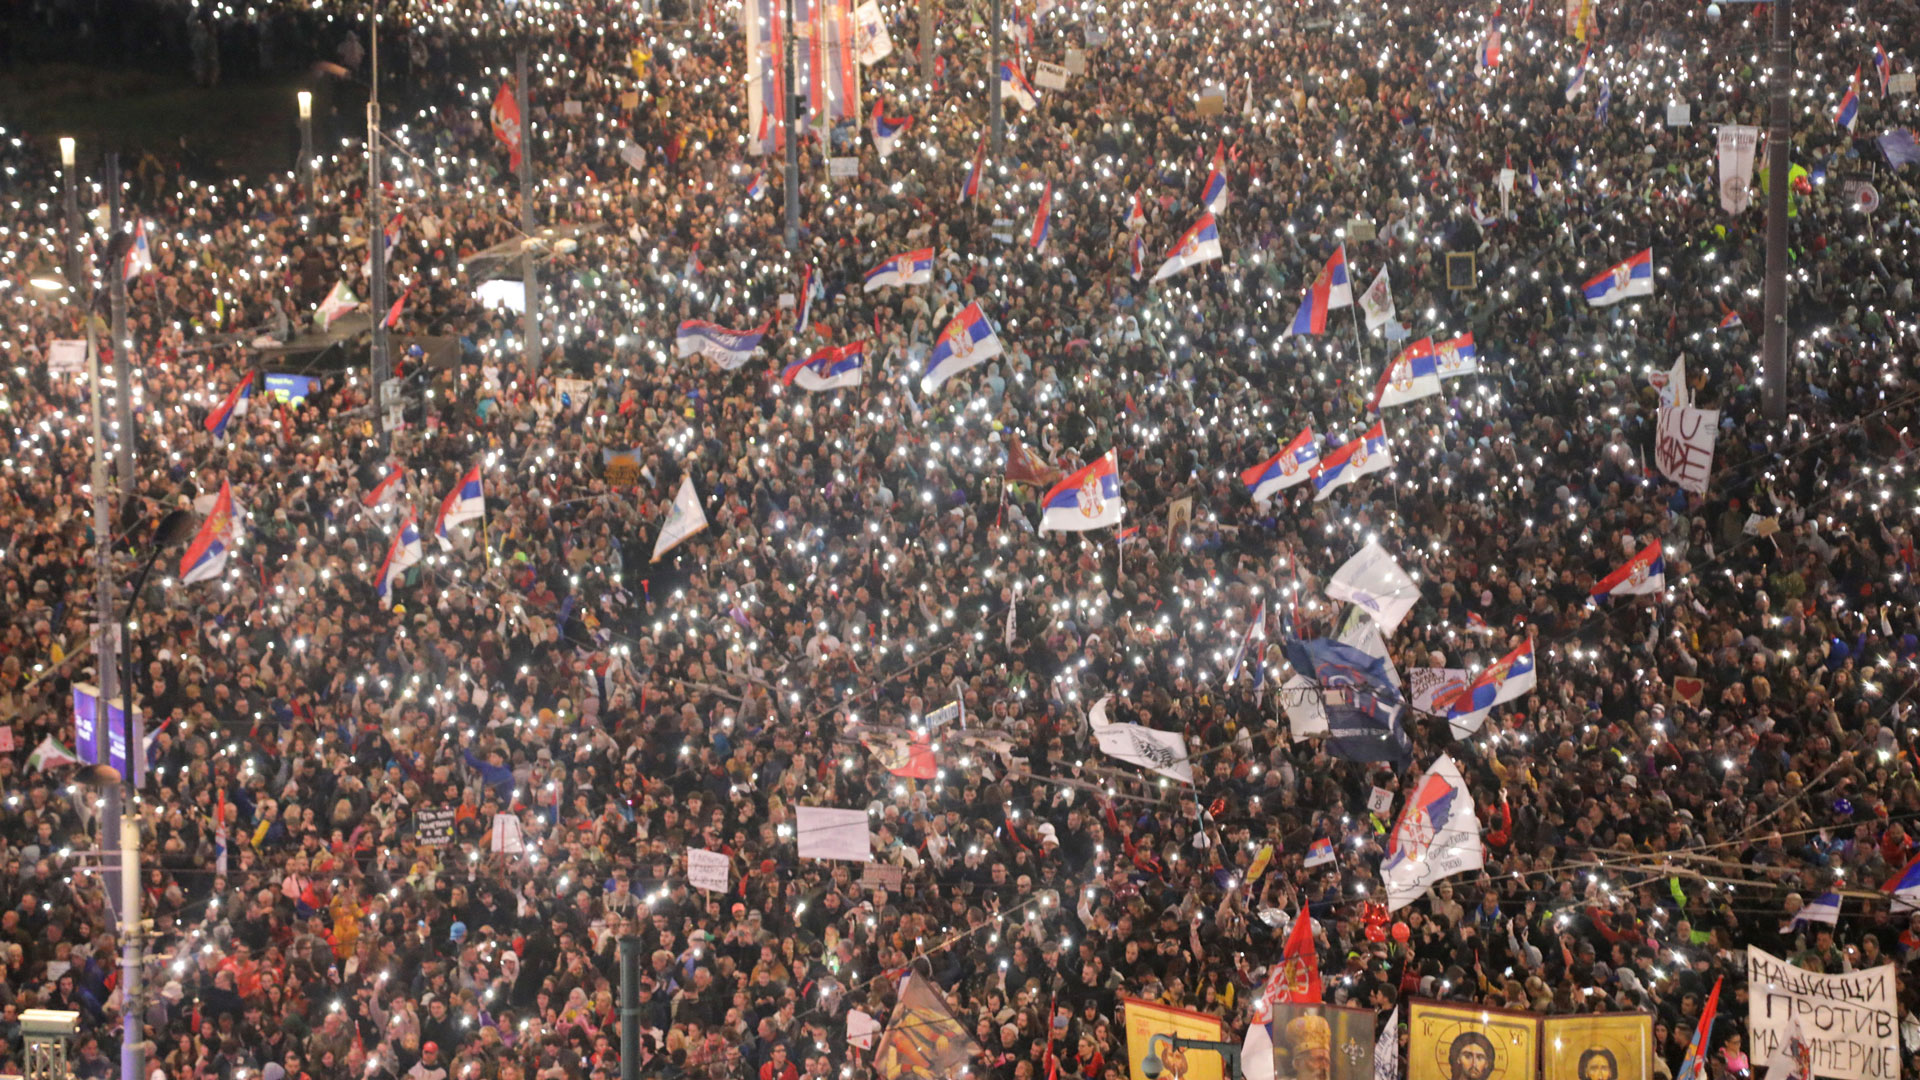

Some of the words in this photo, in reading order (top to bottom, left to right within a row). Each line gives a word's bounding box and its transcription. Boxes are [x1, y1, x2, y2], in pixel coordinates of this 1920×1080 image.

[1680, 409, 1702, 441] U
[1752, 957, 1885, 1003] МАШИНЦИ
[1766, 993, 1892, 1038] ПРОТИВ
[1753, 1028, 1896, 1079] МАИНЕРИЈЕ
